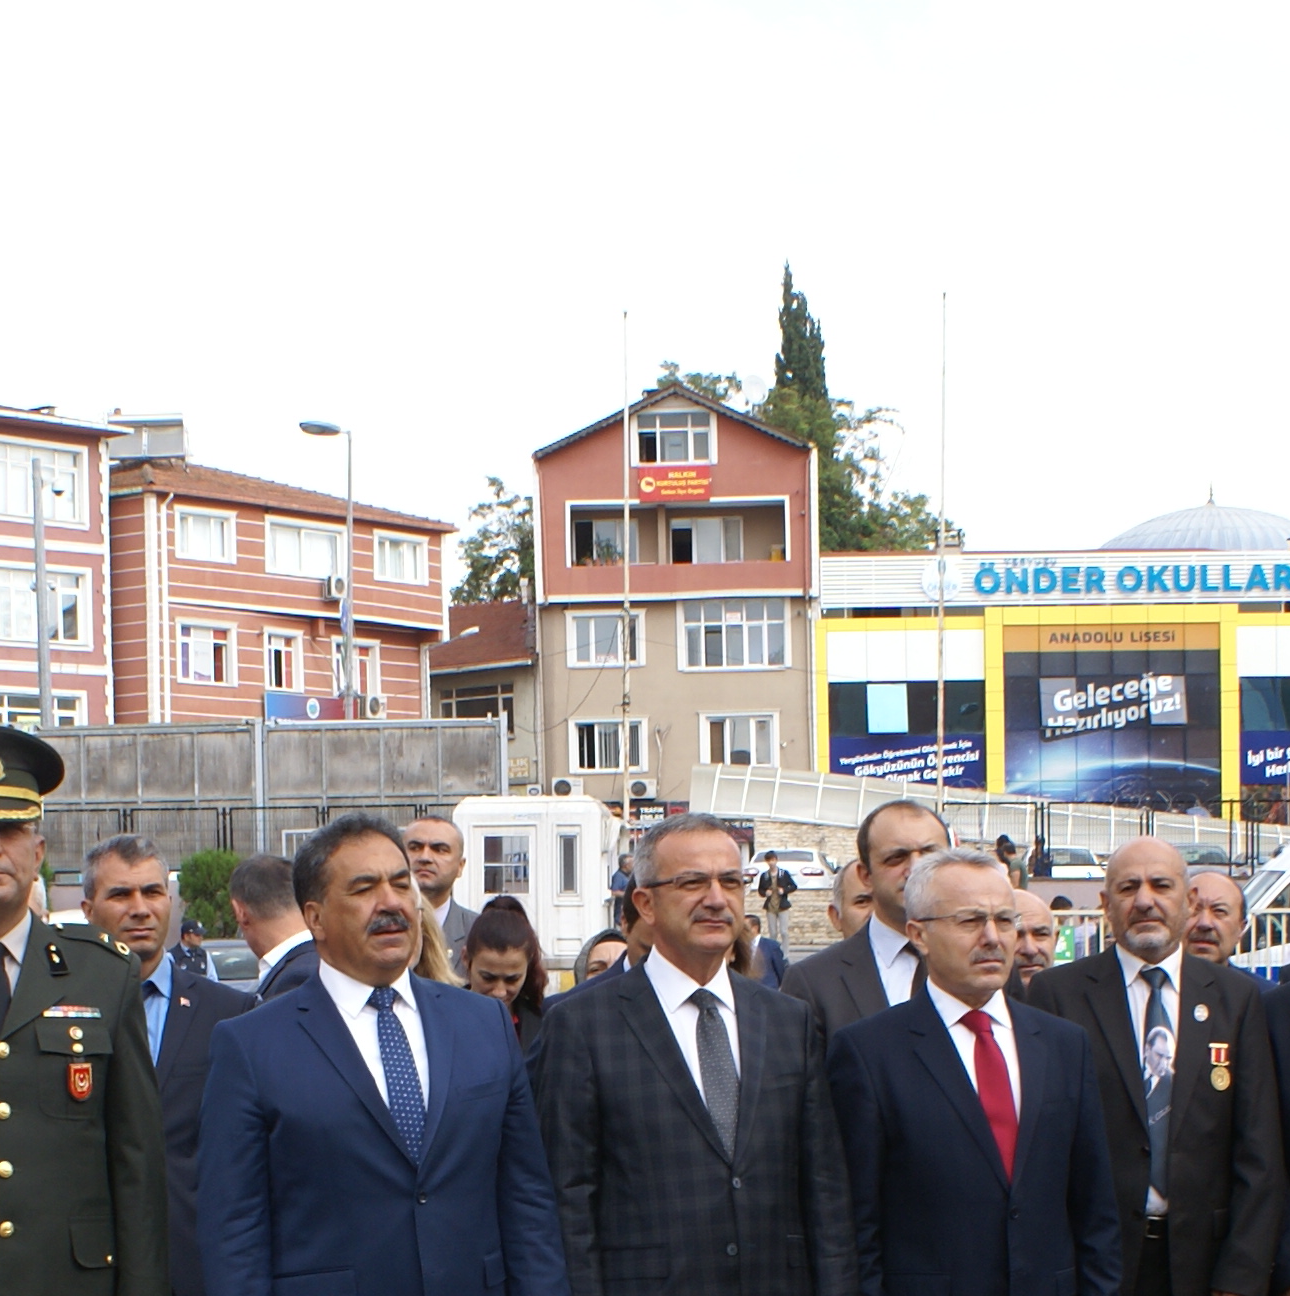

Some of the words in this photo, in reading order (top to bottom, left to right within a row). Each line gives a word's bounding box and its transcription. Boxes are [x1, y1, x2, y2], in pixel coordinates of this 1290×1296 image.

[973, 562, 1106, 596] ÖNDER
[1049, 631, 1123, 644] ANADOLU
[1053, 672, 1172, 712] Geleceğe
[1266, 746, 1284, 760] bir
[854, 758, 925, 777] Gökyüzünün
[923, 765, 965, 780] Geekir
